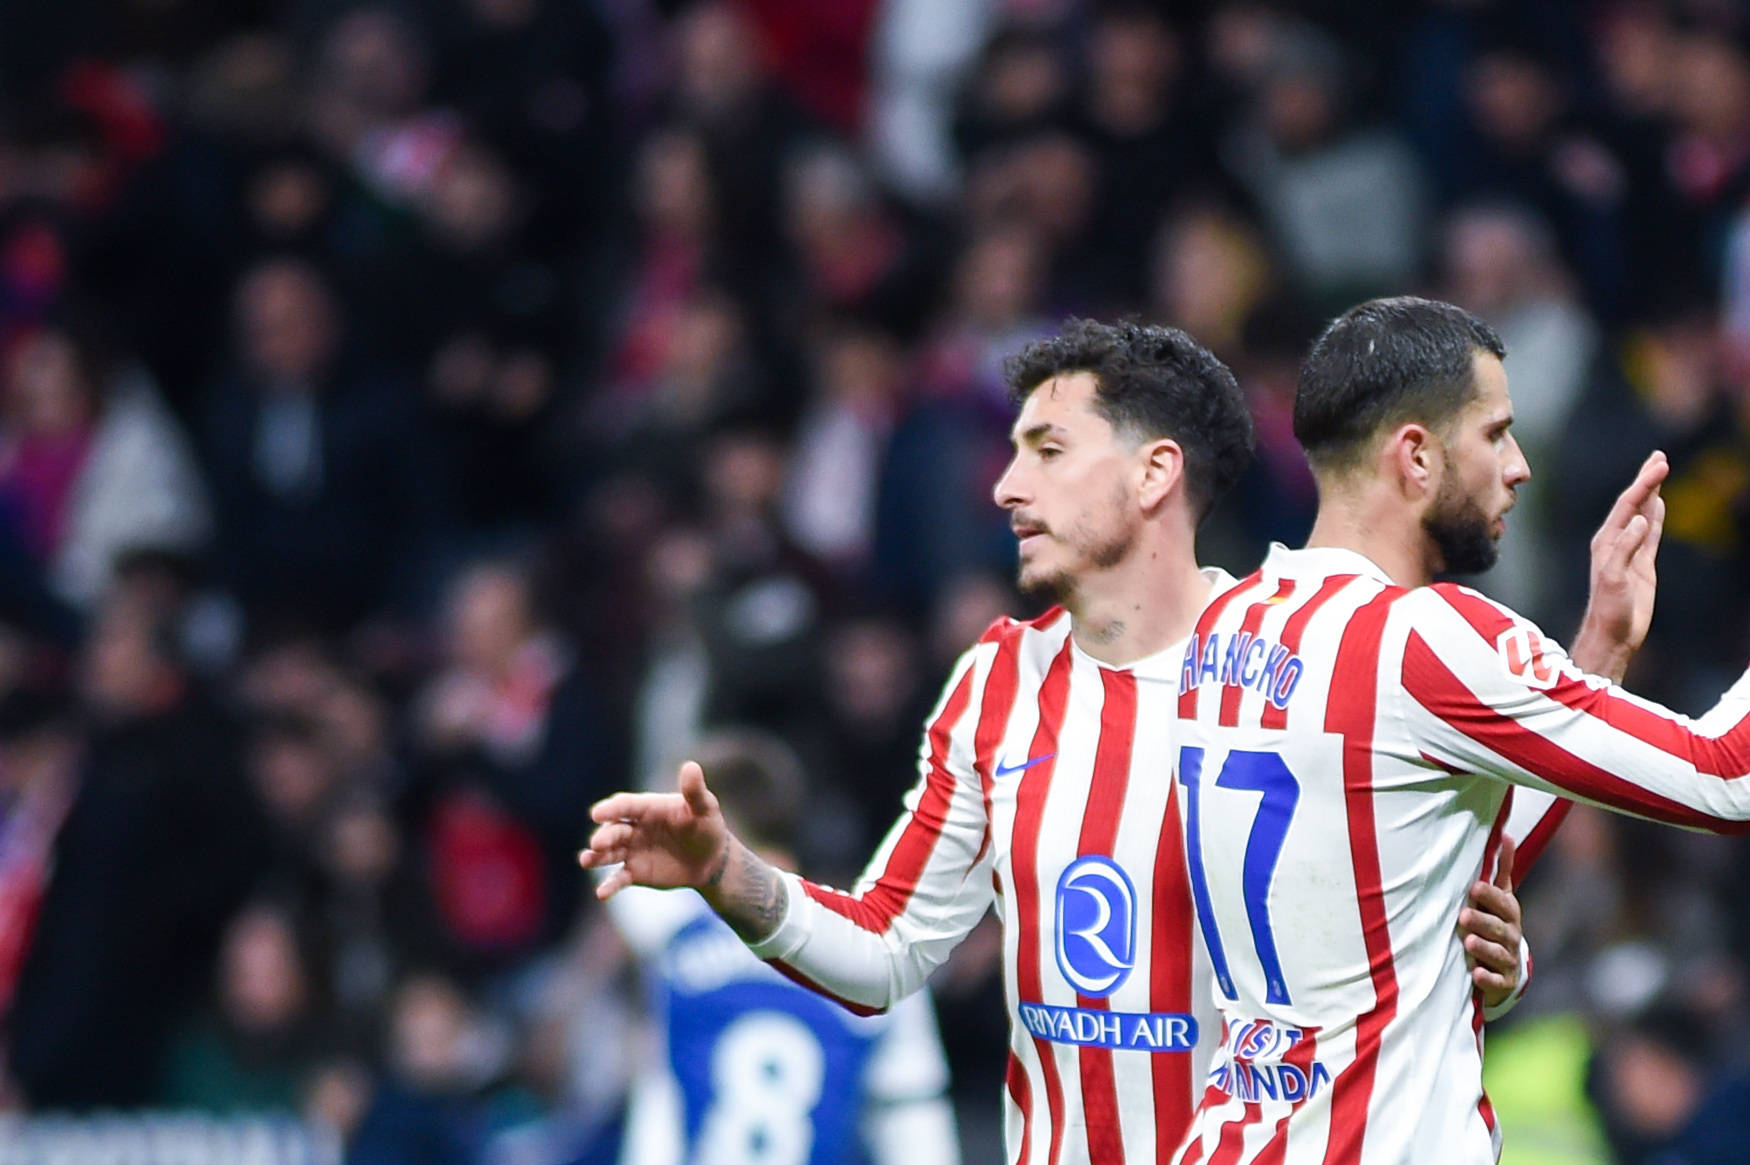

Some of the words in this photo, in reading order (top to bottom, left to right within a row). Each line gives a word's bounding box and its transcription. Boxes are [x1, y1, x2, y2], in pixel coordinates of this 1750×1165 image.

[1178, 631, 1303, 709] HANCKO
[1179, 746, 1300, 1006] 17
[1023, 1005, 1122, 1045] RIYADH
[1131, 1017, 1190, 1047] AIR
